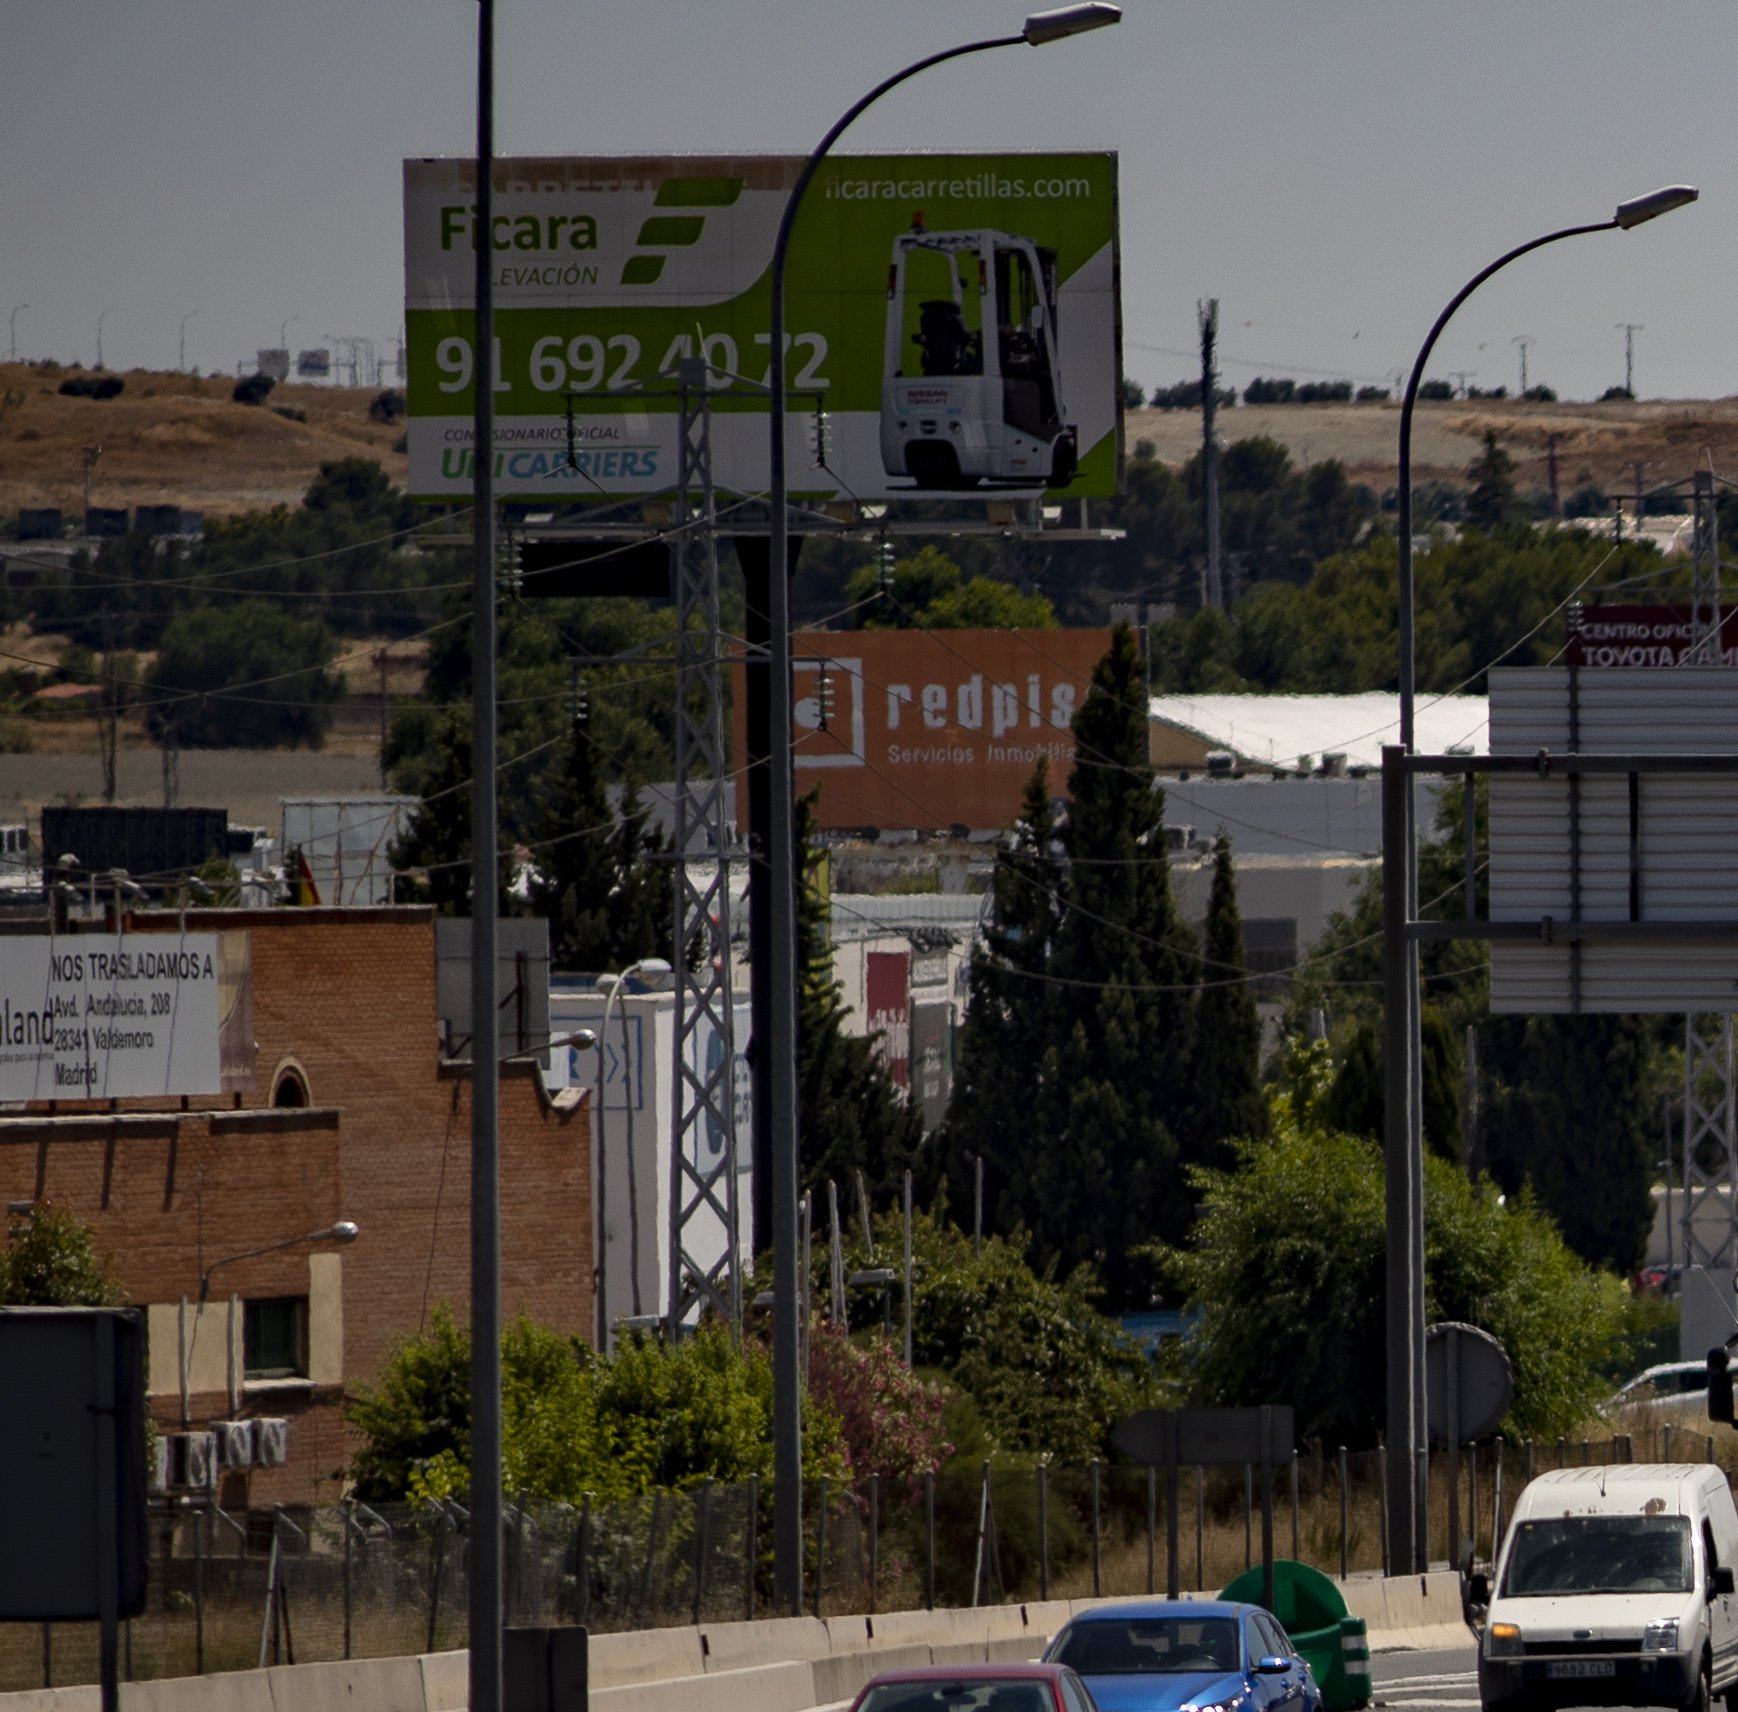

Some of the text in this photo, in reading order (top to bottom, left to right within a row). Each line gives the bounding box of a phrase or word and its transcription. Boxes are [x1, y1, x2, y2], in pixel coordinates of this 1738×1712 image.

[529, 334, 642, 392] 692
[753, 331, 831, 389] 72
[1583, 645, 1674, 667] TOYOTA
[52, 952, 215, 982] NOS TRASLADAMOS A
[0, 998, 54, 1046] land
[54, 1061, 98, 1086] Madrid
